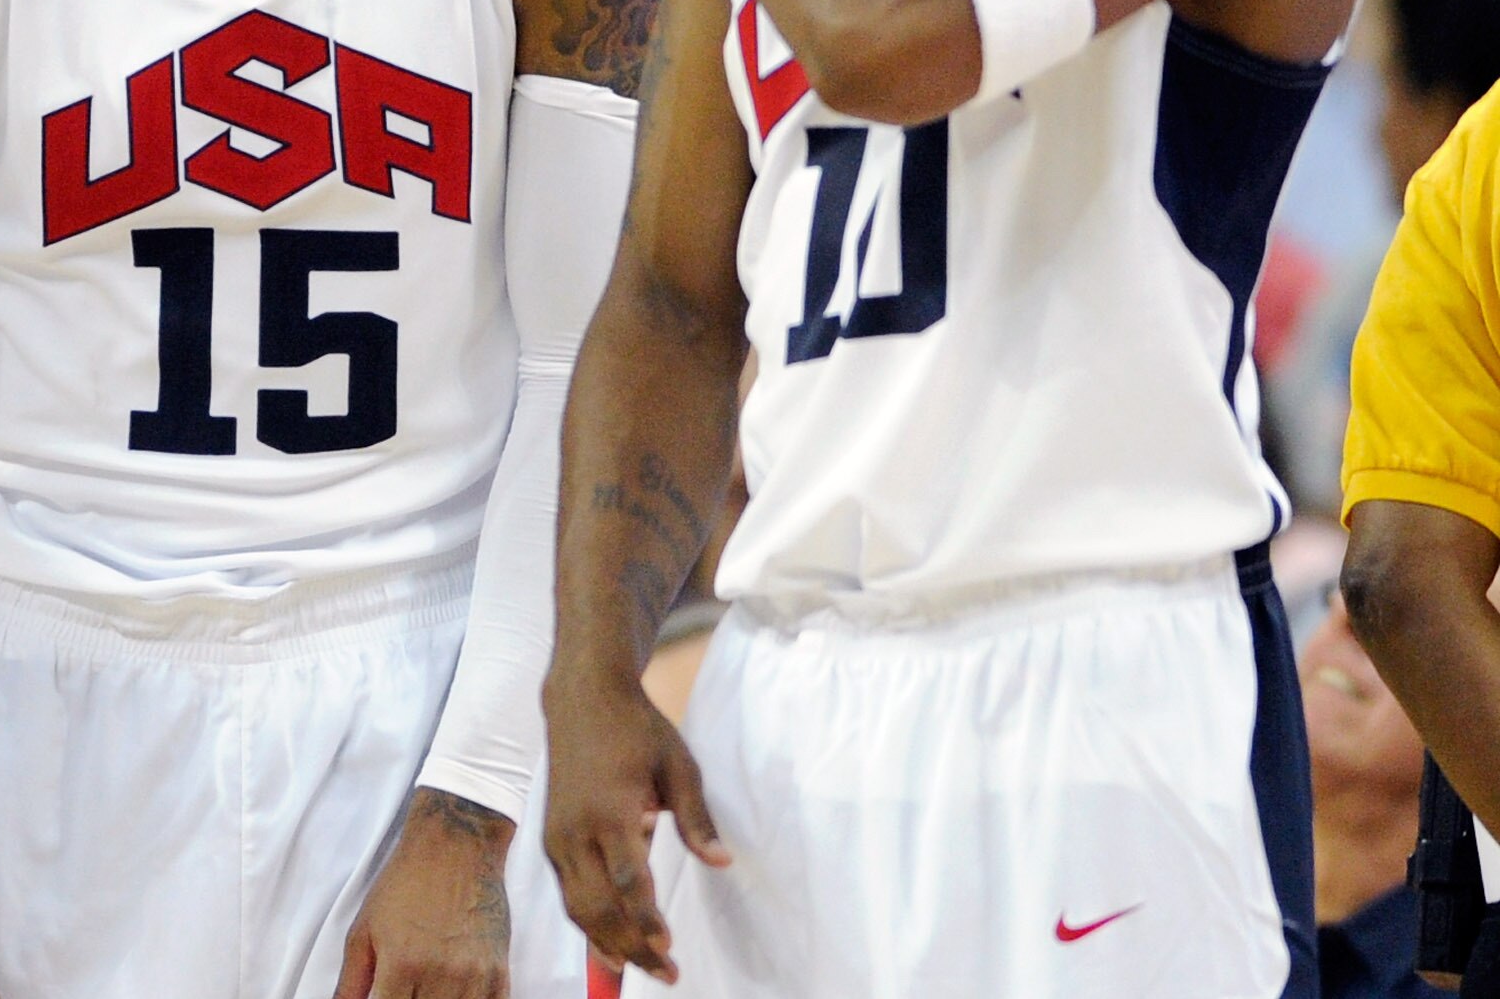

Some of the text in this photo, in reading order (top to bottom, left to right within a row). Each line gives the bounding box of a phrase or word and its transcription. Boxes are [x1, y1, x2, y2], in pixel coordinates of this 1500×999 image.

[42, 8, 472, 248] USA
[785, 113, 949, 366] 10
[128, 227, 400, 456] 15
